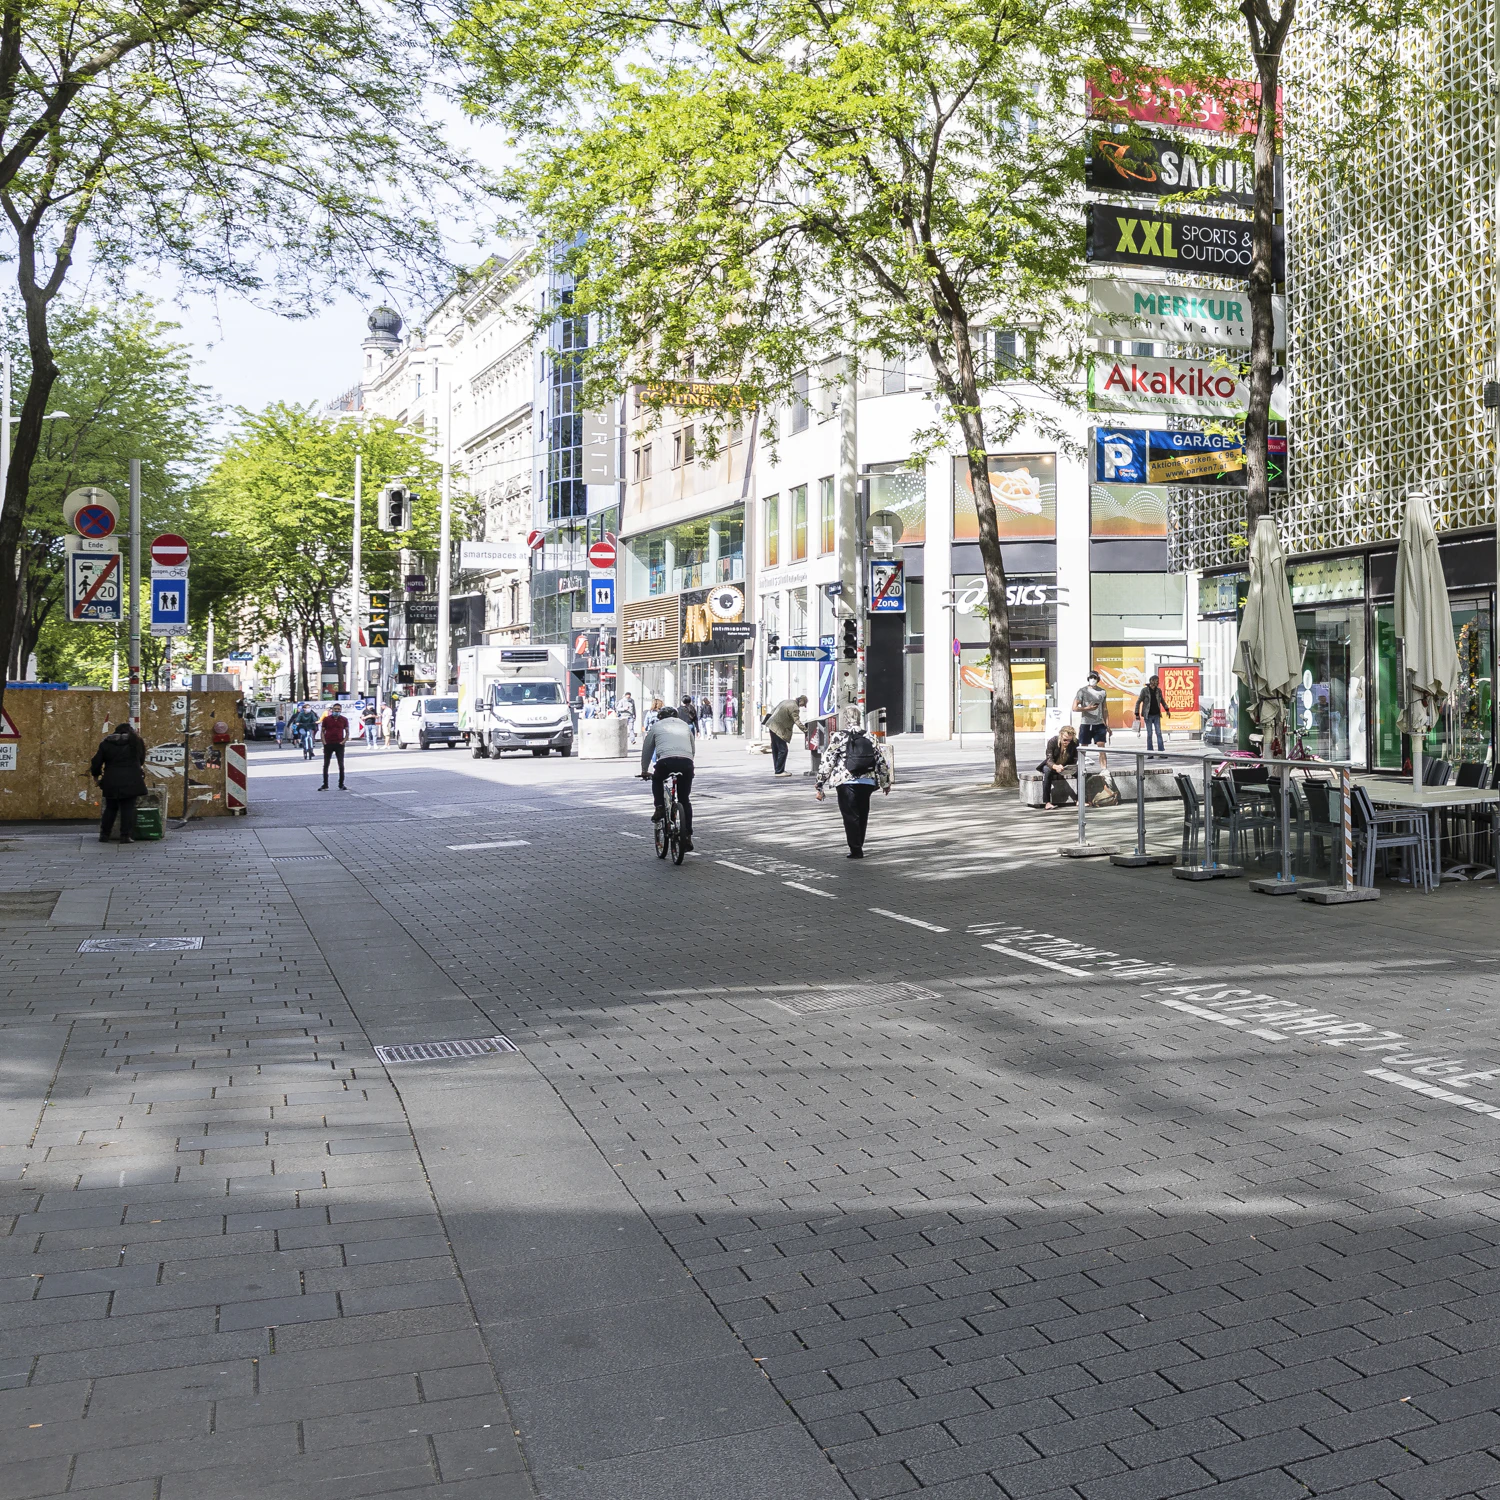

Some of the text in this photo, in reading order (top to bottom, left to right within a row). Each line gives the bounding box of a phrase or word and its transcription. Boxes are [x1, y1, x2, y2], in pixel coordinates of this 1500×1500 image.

[1161, 150, 1256, 196] SATUR
[1115, 216, 1178, 259] XXL
[1182, 225, 1253, 247] SPORTS &
[1181, 244, 1253, 265] OUTDOO
[1133, 292, 1244, 322] MERKUR
[1183, 322, 1245, 337] Markt
[1103, 362, 1236, 399] Akakiko
[1103, 393, 1241, 407] EASY JAPANESE DINING
[1173, 434, 1231, 449] GARAGE
[1165, 462, 1227, 478] www.parken7.at
[88, 541, 104, 549] Ende
[100, 586, 115, 598] 20
[890, 585, 900, 595] 20
[877, 599, 899, 607] Zone
[627, 616, 667, 643] ESPRIT
[786, 649, 815, 658] EINBAHN
[1164, 676, 1195, 690] DAS
